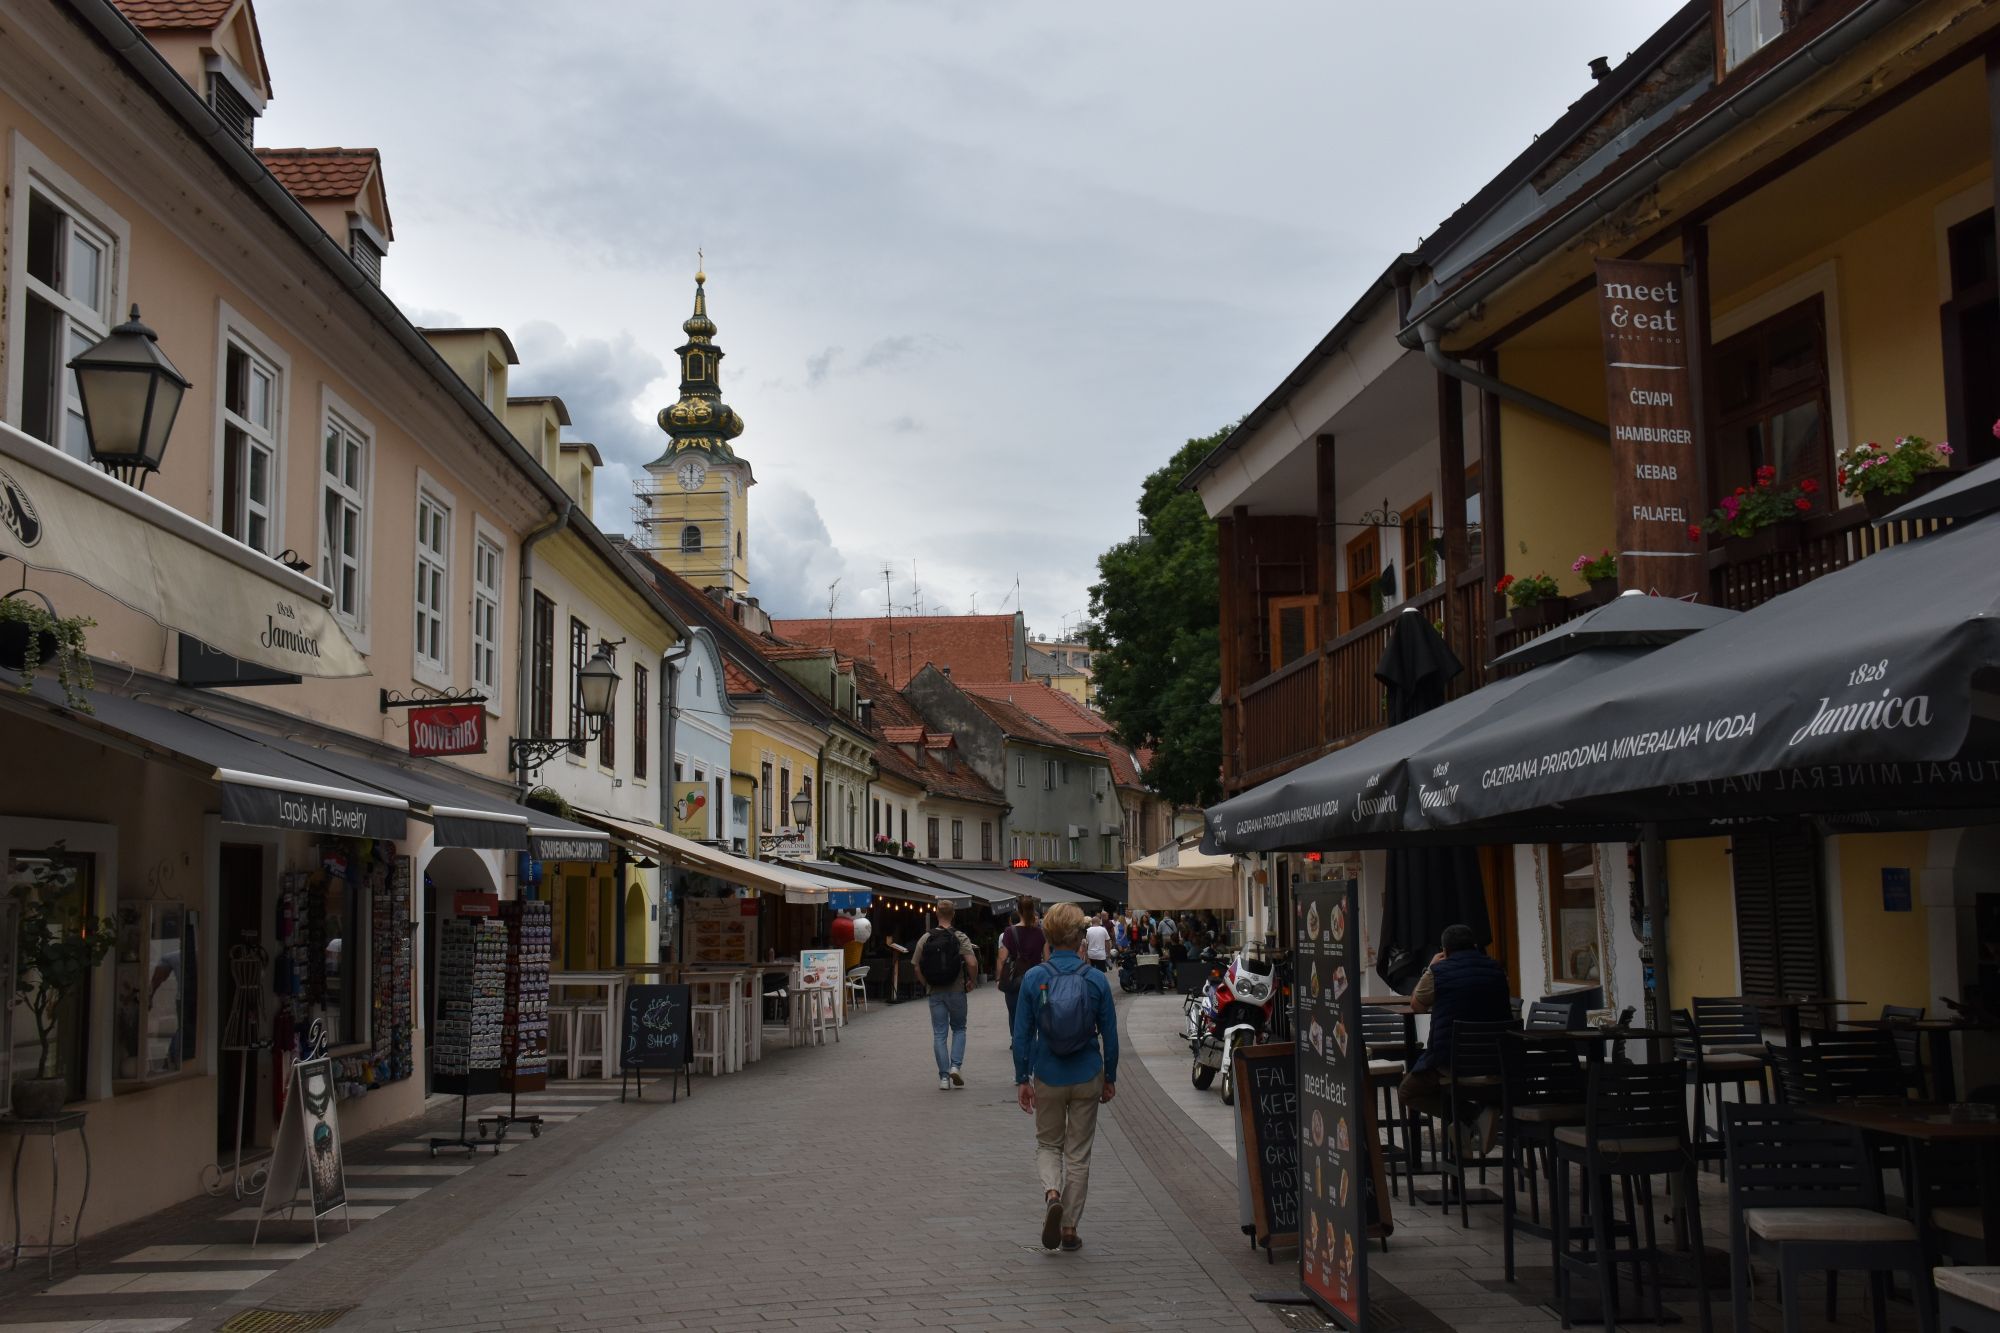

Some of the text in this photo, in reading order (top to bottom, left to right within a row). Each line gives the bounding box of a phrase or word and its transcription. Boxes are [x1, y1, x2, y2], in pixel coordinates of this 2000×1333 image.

[1604, 281, 1679, 303] meet
[1611, 304, 1678, 332] & eat
[1629, 387, 1674, 407] ĆEVAPI
[1615, 425, 1692, 445] HAMBURGER
[1635, 463, 1678, 481] KEBAB
[1632, 505, 1687, 523] FALAFEL
[261, 615, 321, 658] Jamnica
[1847, 658, 1889, 687] 1828
[1788, 687, 1934, 746] Jamnica
[414, 715, 479, 750] SOUVENIRS
[1481, 711, 1757, 790] GAZIRANA PRIRODNA MINERALNA VODA
[279, 795, 367, 835] Lapis Art Jewelry
[1236, 817, 1263, 836] GAZIRANA
[1263, 808, 1291, 832] PRIRODNA
[1290, 804, 1322, 825] MINERALNA
[1321, 799, 1339, 818] VODA
[1352, 790, 1398, 823] Jamnica
[1013, 860, 1029, 868] HRK
[647, 1033, 679, 1048] SHOP
[1304, 1073, 1347, 1106] meet&eat
